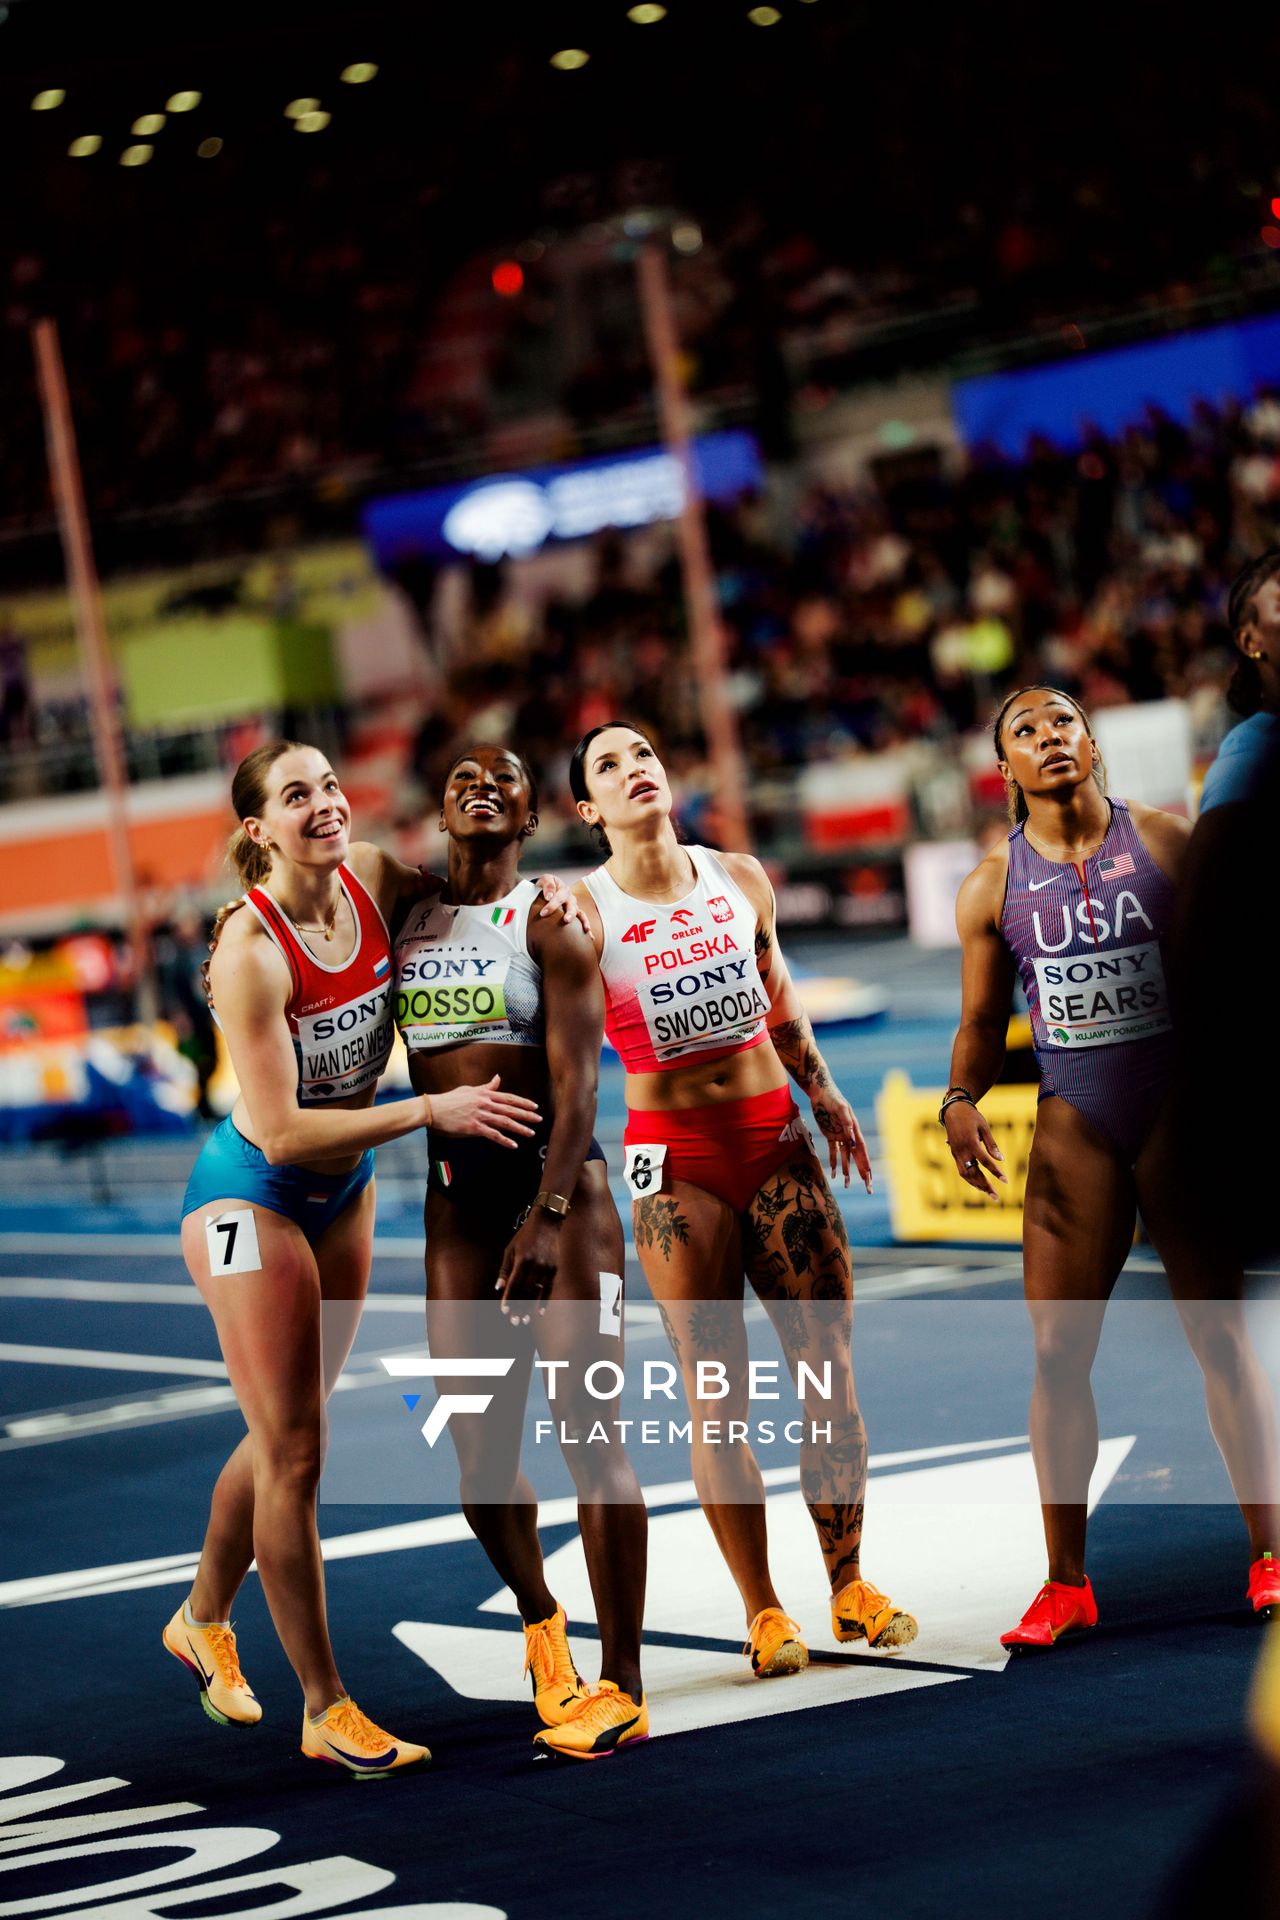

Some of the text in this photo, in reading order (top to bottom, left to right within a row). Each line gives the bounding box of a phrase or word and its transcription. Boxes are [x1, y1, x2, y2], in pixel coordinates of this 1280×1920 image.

[621, 919, 657, 944] 4F
[671, 926, 703, 940] ORLEN
[1032, 891, 1153, 953] USA
[401, 958, 496, 983] SONY
[644, 933, 738, 975] POLSKA
[1044, 953, 1148, 985] SONY
[650, 959, 748, 1006] SONY
[301, 996, 329, 1013] CRAFT
[312, 987, 391, 1041] SONY
[394, 986, 495, 1021] DOSSO
[654, 988, 767, 1042] SWOBODA
[1049, 981, 1160, 1022] SEARS
[412, 1032, 445, 1041] KUJAWY
[447, 1026, 490, 1040] POMORZE
[1075, 1030, 1112, 1041] KUJAWY
[308, 1048, 340, 1079] VAN
[342, 1037, 366, 1070] DER
[631, 1153, 652, 1190] 8
[216, 1221, 239, 1266] 7
